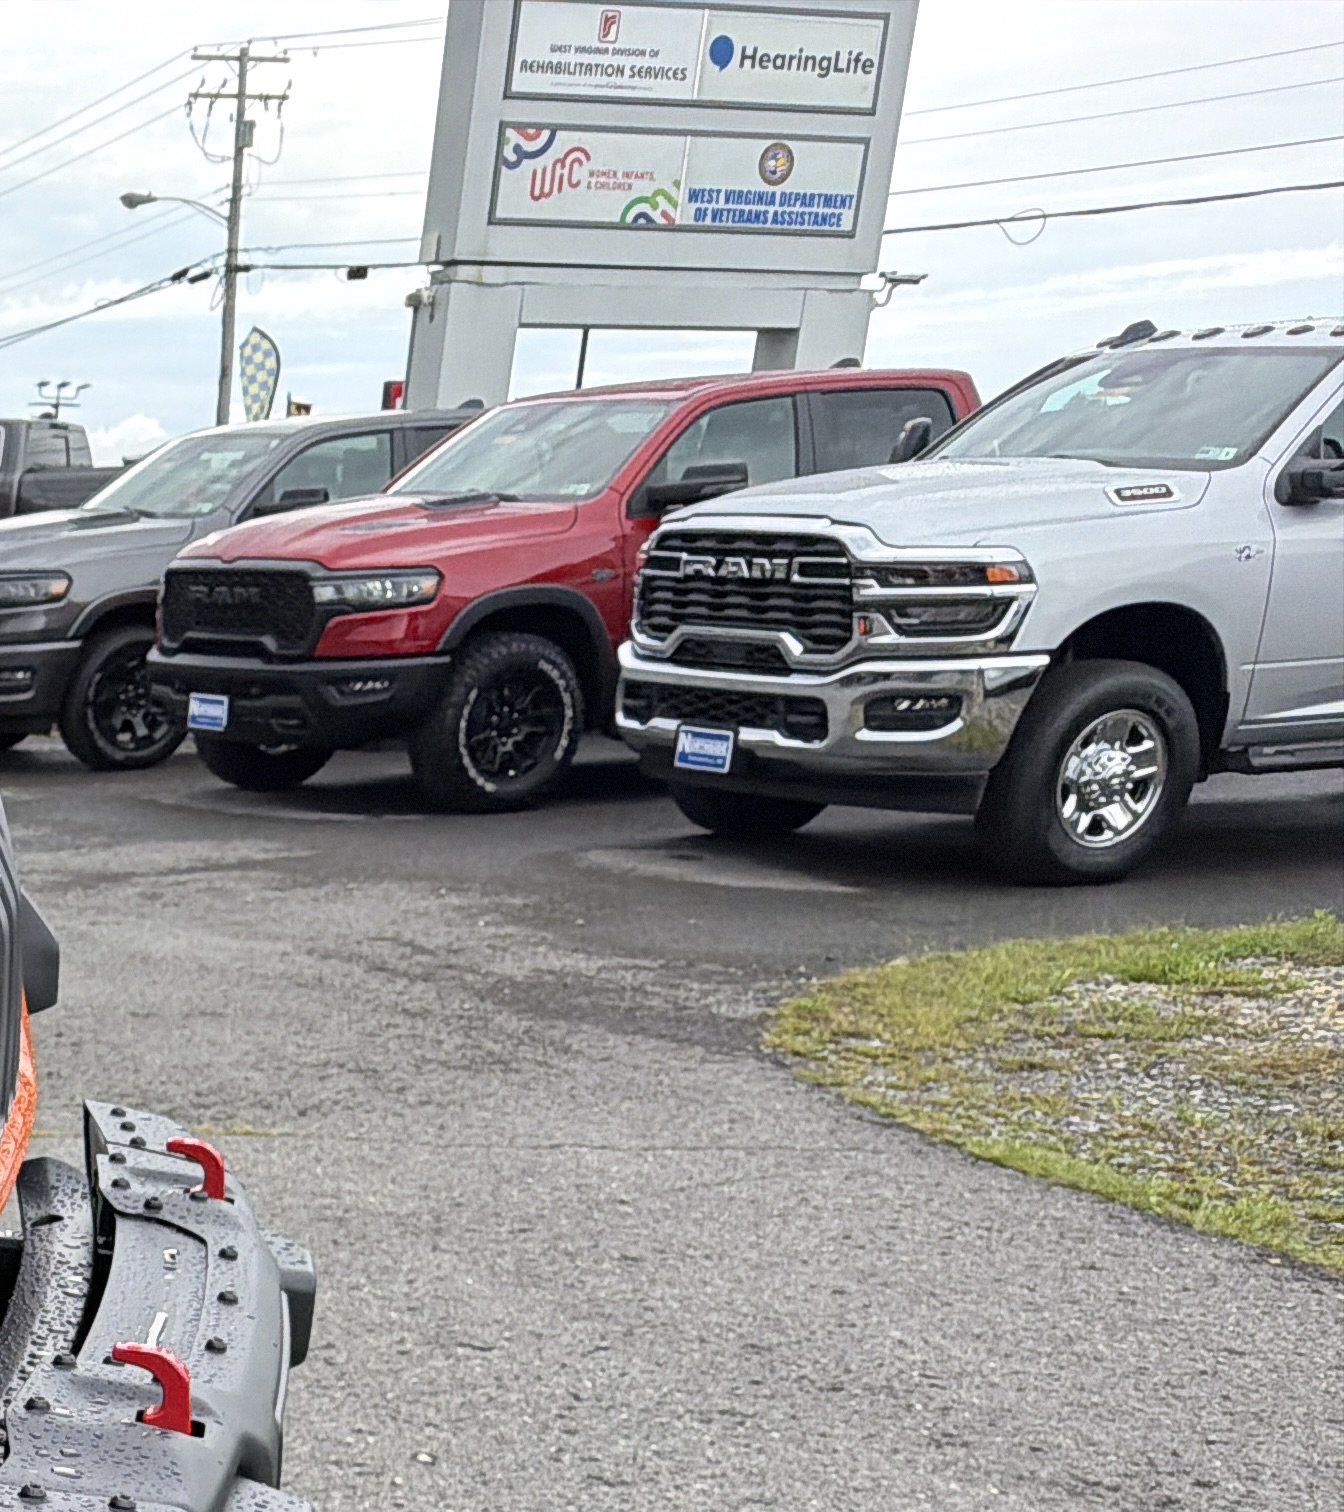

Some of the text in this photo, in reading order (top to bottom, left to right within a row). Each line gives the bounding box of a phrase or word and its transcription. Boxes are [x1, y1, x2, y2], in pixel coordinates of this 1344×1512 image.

[550, 43, 661, 58] WEST VIRGINIA DIVISION OF
[739, 45, 875, 78] HearingLife
[519, 59, 688, 82] REHABILITATION SERVICES
[594, 181, 633, 191] CHILDREN
[688, 187, 854, 210] WEST VIRGINIA DEPARTMENT
[693, 207, 843, 228] OF VETERANS ASSISTANCE
[683, 555, 790, 579] RAM
